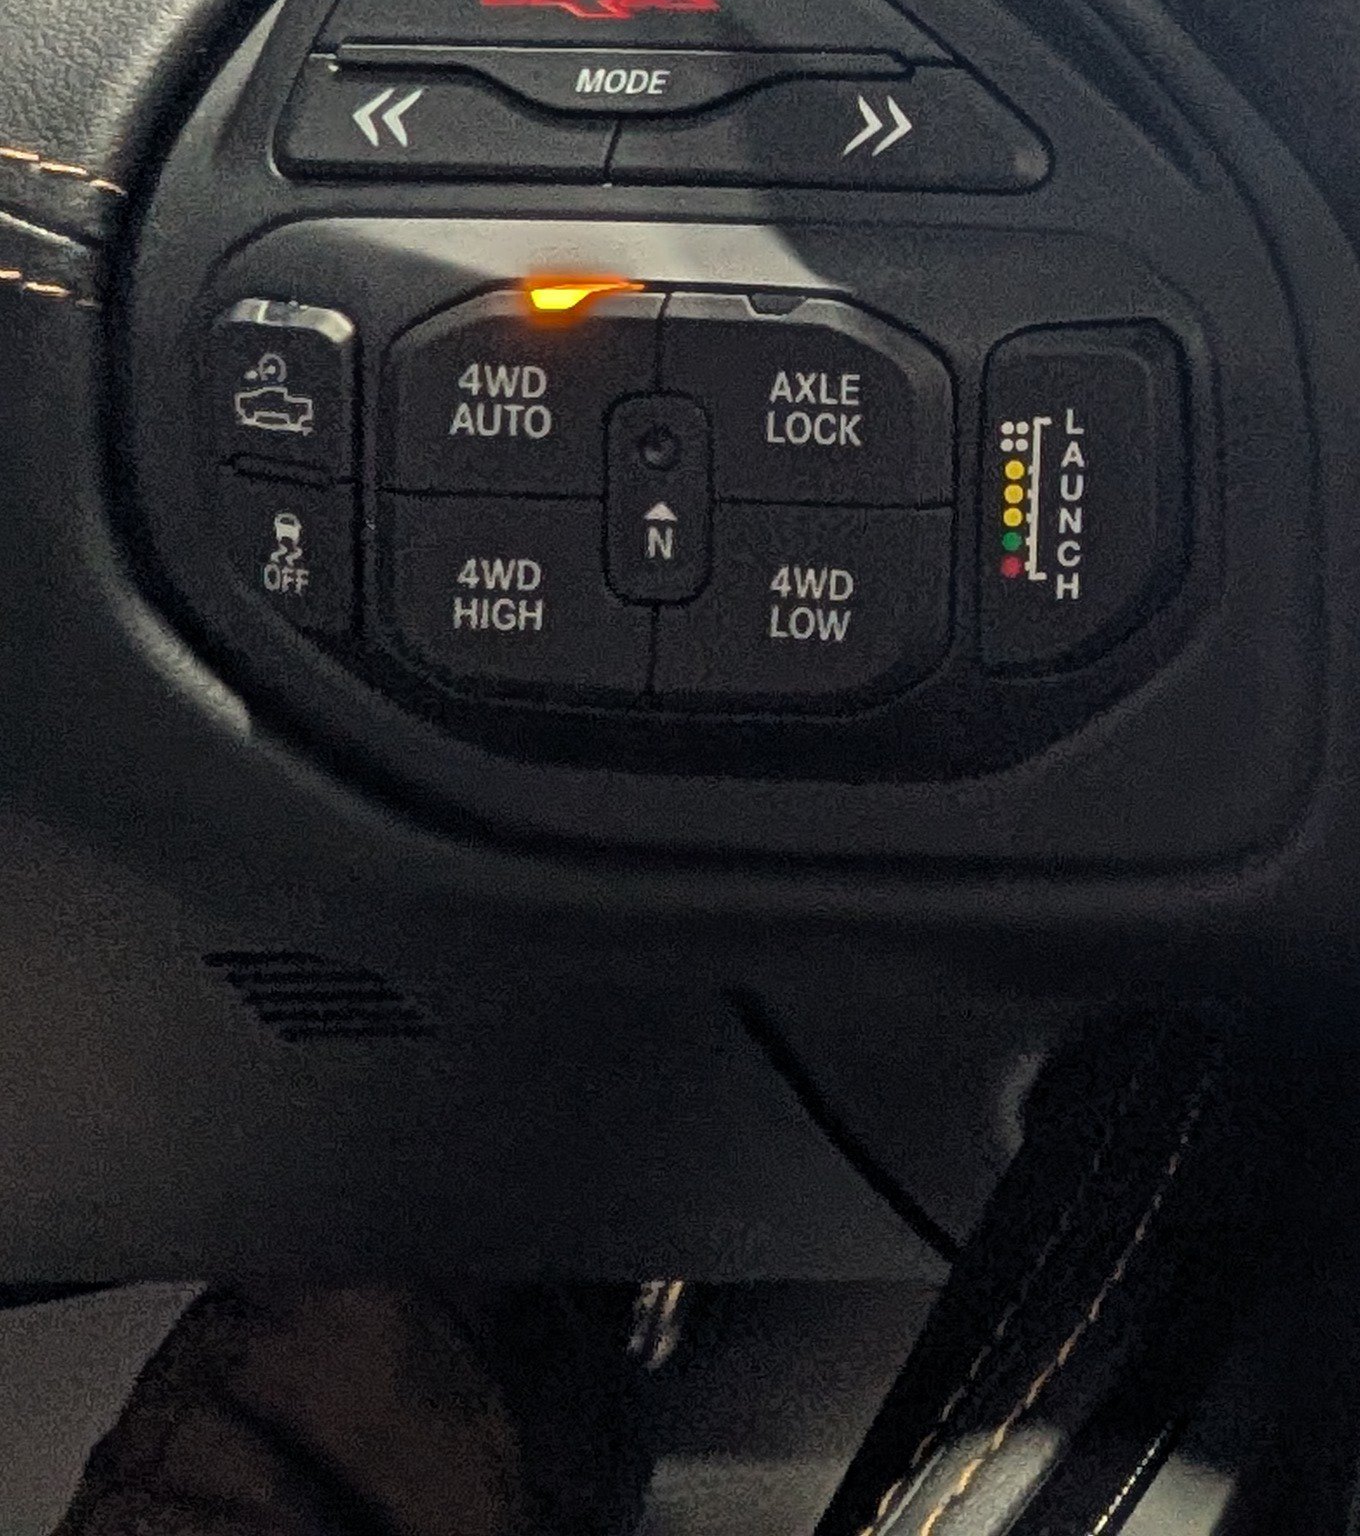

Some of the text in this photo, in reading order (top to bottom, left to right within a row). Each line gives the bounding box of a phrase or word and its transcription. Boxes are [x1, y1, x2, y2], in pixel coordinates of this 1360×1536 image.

[575, 67, 671, 96] MODE
[457, 364, 548, 399] 4WD
[769, 370, 862, 407] AXLE
[449, 403, 553, 439] AUTO
[765, 411, 862, 448] LOCK
[1055, 407, 1086, 601] LAUNCH
[645, 525, 674, 560] N
[262, 563, 310, 595] OFF
[456, 558, 542, 592] 4WD
[769, 566, 854, 602] 4WD
[452, 596, 544, 632] HIGH
[768, 606, 852, 642] LOW
